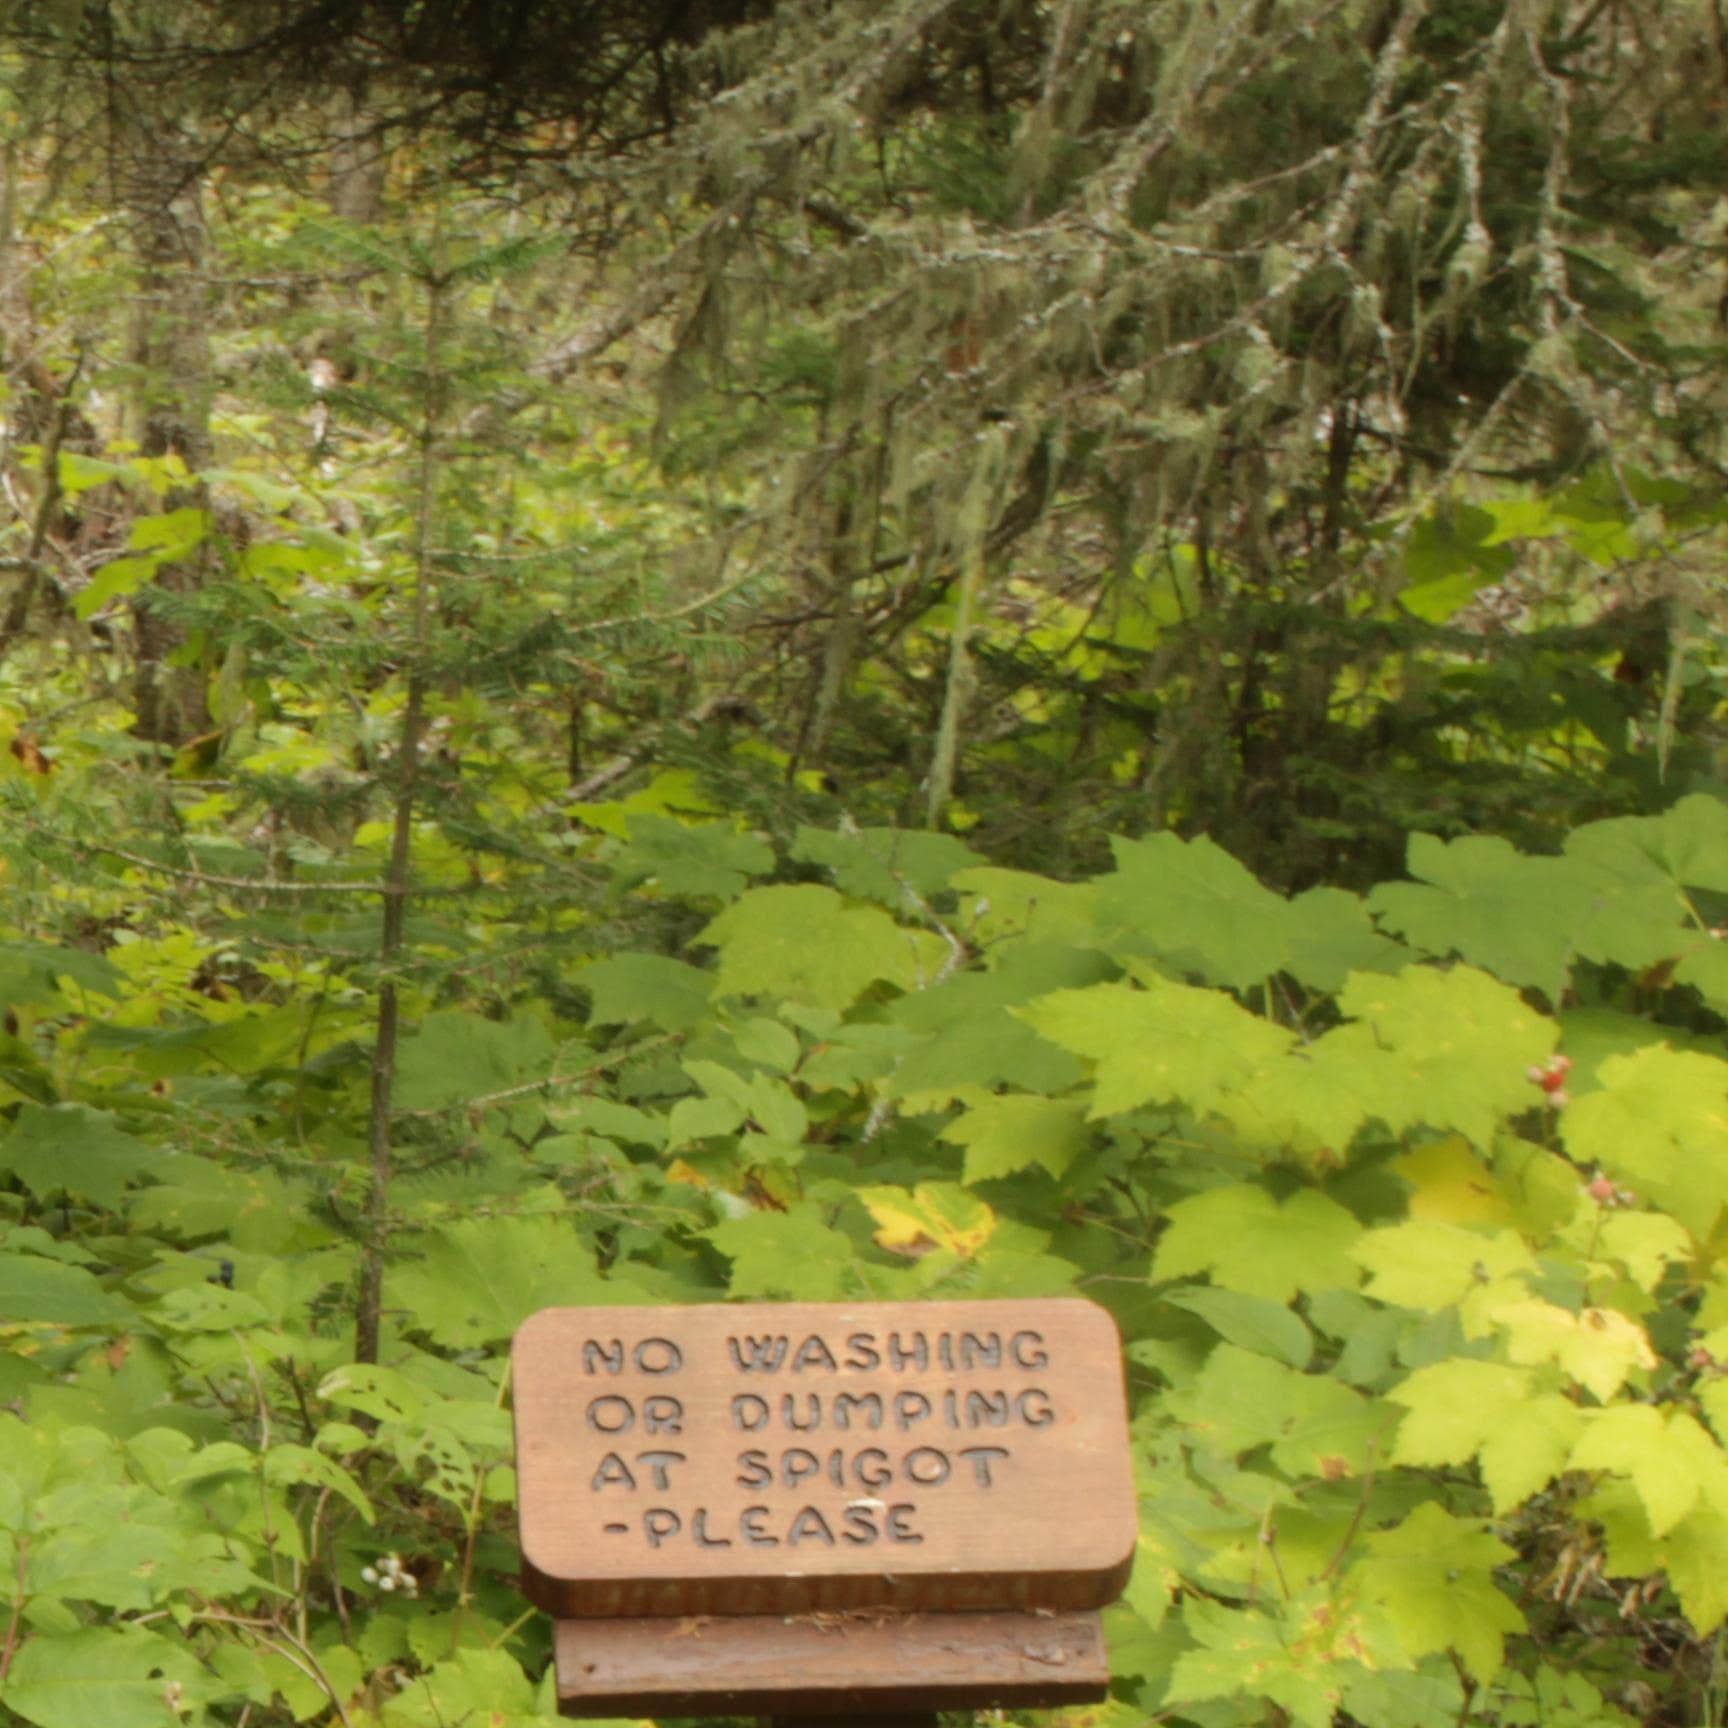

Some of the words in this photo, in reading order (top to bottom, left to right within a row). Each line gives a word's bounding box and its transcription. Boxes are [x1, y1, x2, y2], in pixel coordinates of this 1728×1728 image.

[582, 1336, 684, 1376] NO
[727, 1330, 1049, 1376] WASHING
[586, 1394, 685, 1435] OR
[731, 1389, 1055, 1434] DUMPING
[591, 1450, 687, 1492] AT
[735, 1446, 1010, 1491] SPIGOT
